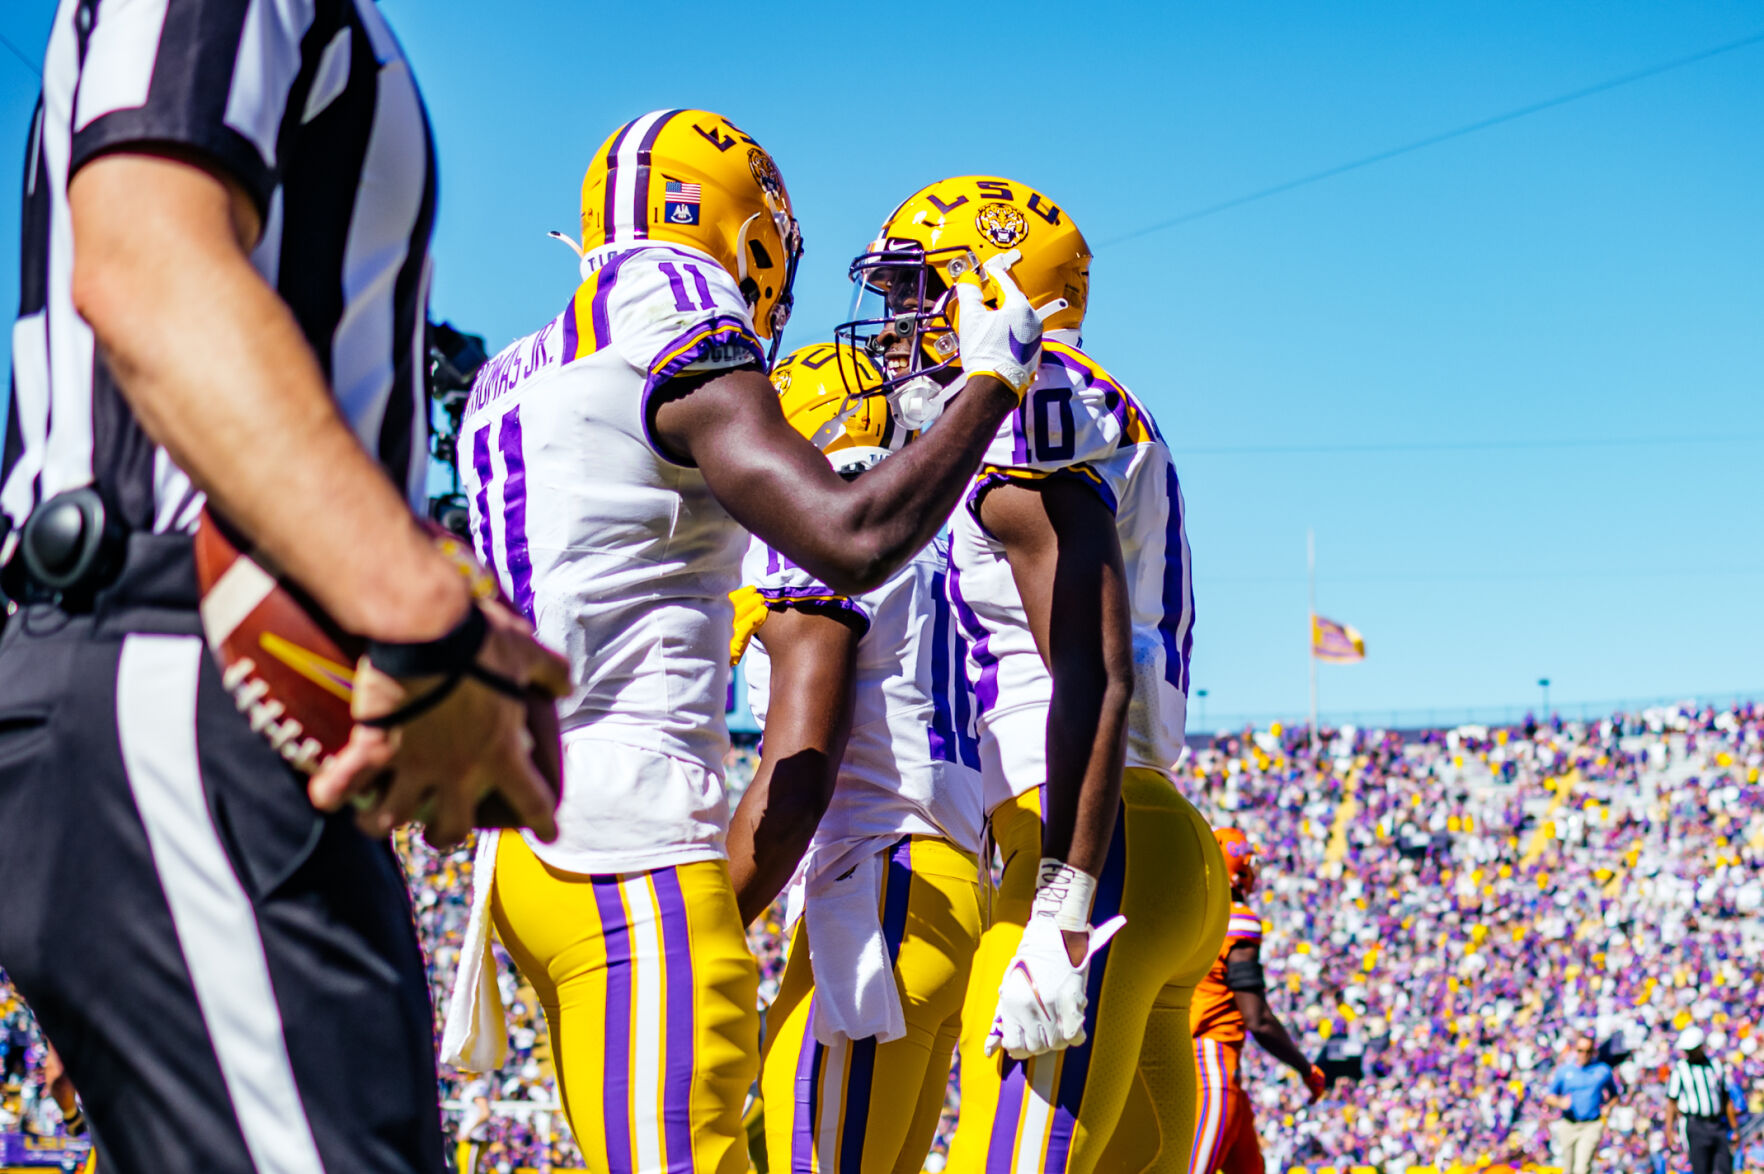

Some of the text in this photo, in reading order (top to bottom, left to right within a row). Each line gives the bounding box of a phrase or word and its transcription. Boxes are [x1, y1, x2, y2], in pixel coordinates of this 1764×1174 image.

[926, 181, 1061, 226] LSU
[658, 261, 719, 312] 11
[523, 317, 557, 379] JR.
[1011, 387, 1076, 465] 10
[473, 403, 538, 628] 11
